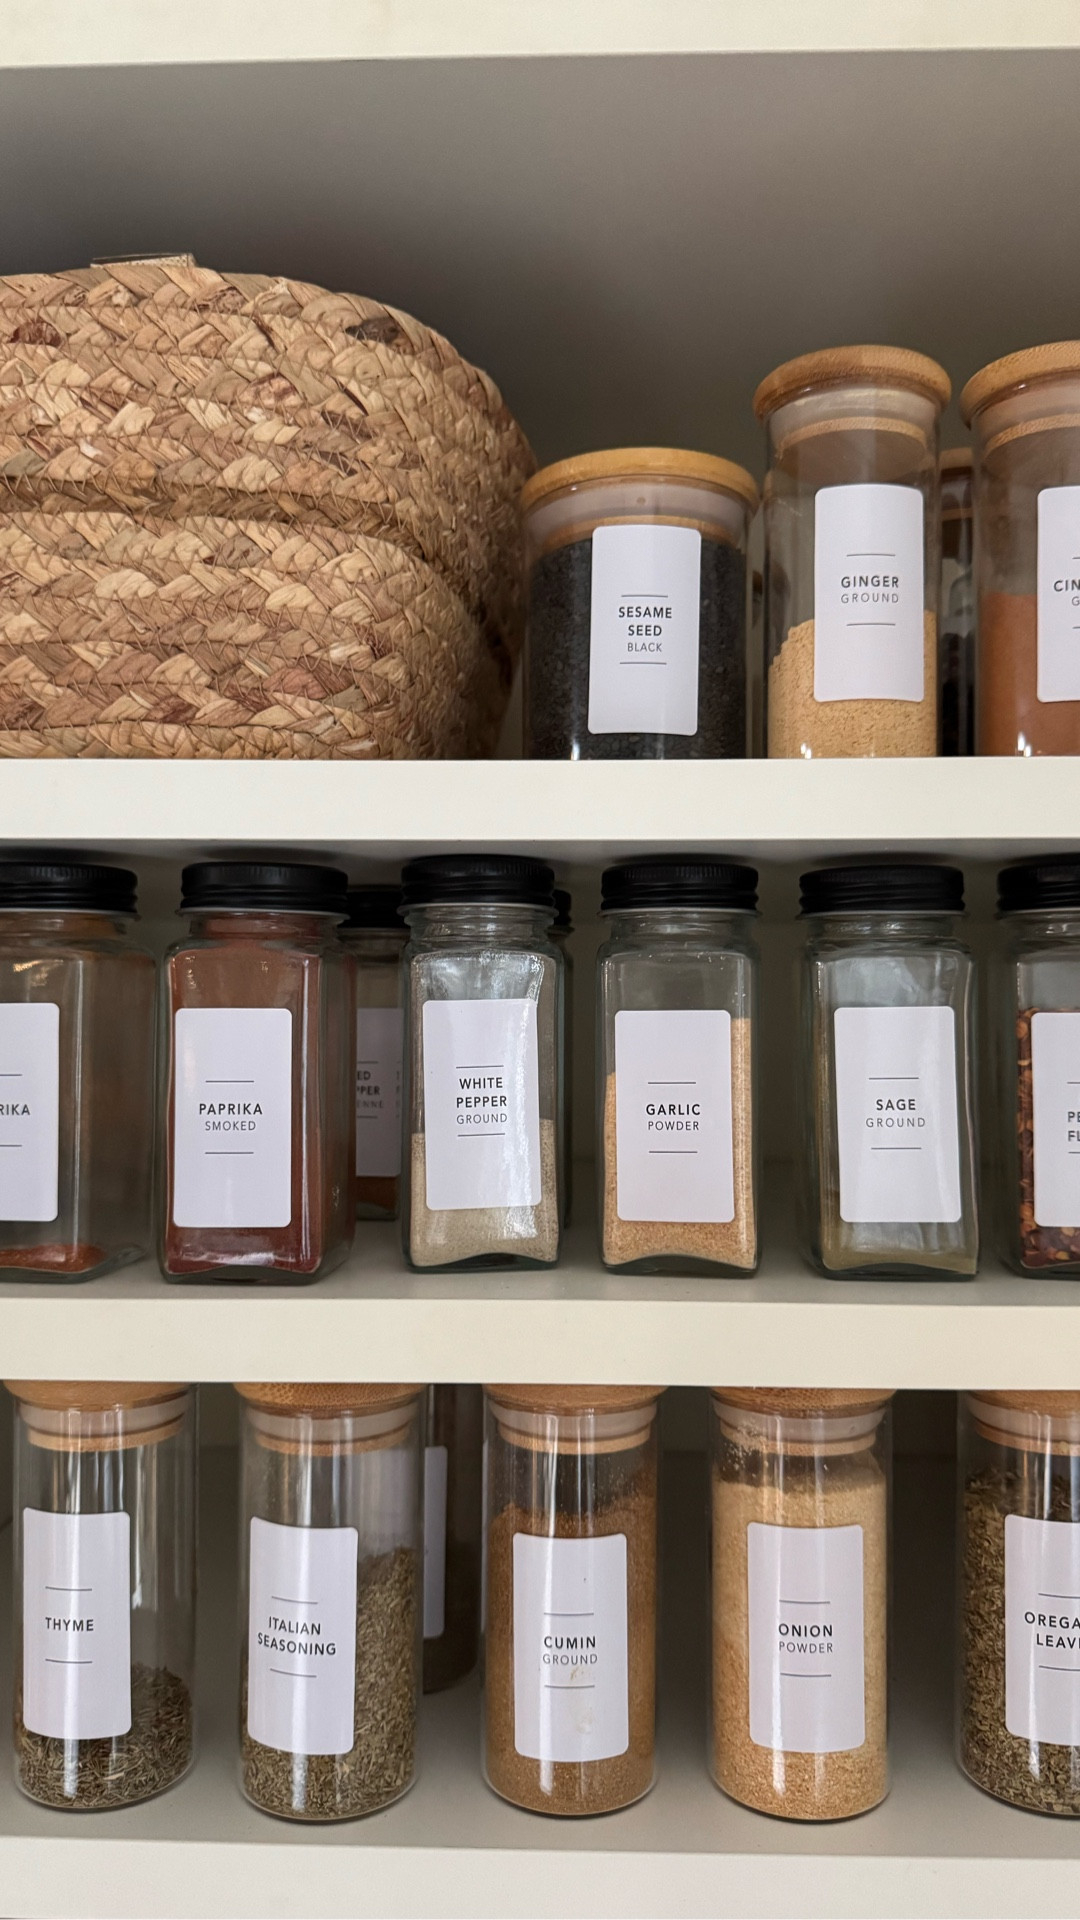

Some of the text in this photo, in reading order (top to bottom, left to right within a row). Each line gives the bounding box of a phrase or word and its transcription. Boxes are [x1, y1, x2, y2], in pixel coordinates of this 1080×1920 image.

[840, 575, 899, 589] GINGER
[840, 592, 899, 604] GROUND
[618, 606, 672, 619] SESAME
[627, 624, 663, 637] SEED
[627, 642, 662, 653] BLACK
[458, 1076, 503, 1090] WHITE
[355, 1084, 382, 1097] PER
[456, 1095, 507, 1109] PEPPER
[875, 1098, 916, 1111] SAGE
[199, 1103, 263, 1116] PAPRIKA
[645, 1103, 701, 1116] GARLIC
[205, 1120, 256, 1131] SMOKED
[456, 1113, 508, 1125] GROUND
[648, 1120, 699, 1131] POWDER
[865, 1117, 926, 1128] GROUND
[44, 1616, 94, 1632] THYME
[267, 1615, 323, 1636] ITALIAN
[778, 1623, 833, 1638] ONION
[256, 1631, 337, 1657] SEASONING
[543, 1635, 596, 1650] CUMIN
[779, 1641, 833, 1654] POWDER
[542, 1653, 598, 1666] GROUND
